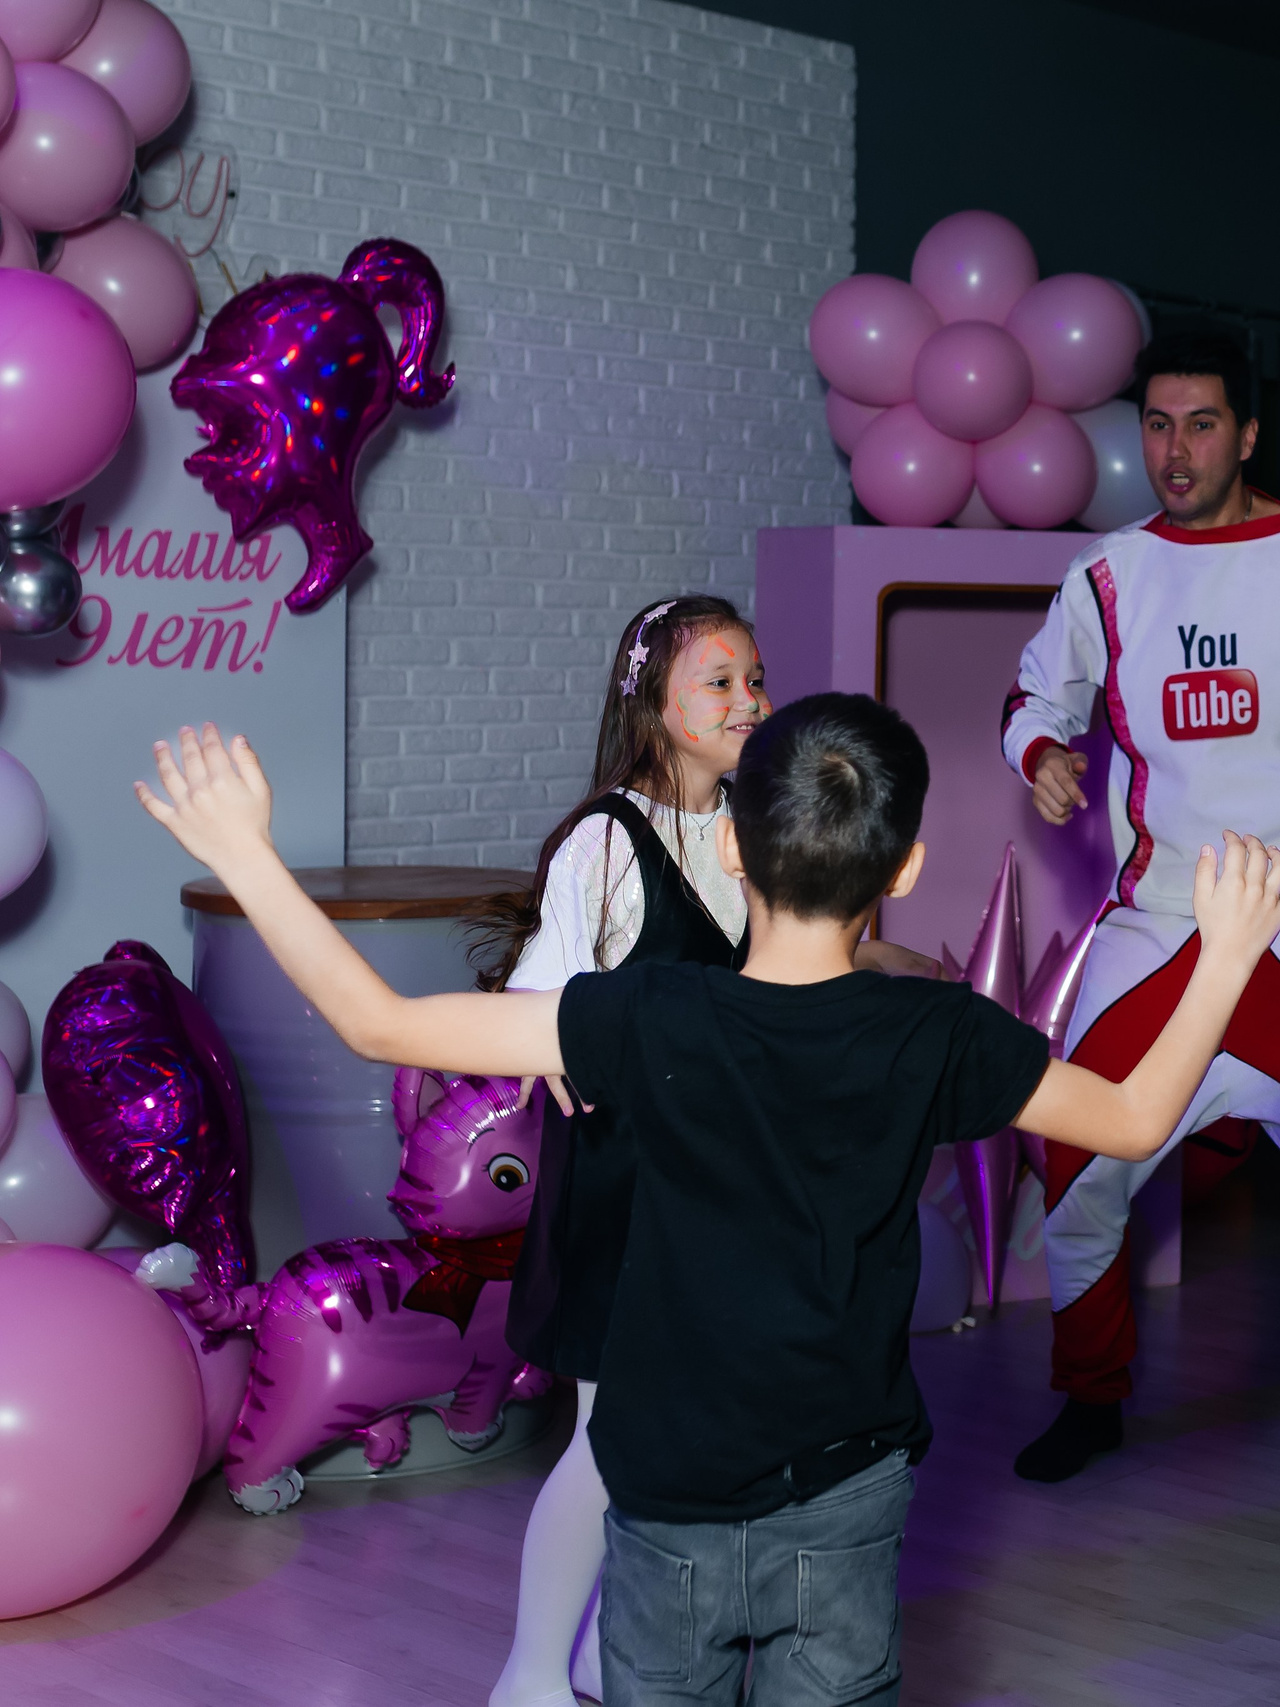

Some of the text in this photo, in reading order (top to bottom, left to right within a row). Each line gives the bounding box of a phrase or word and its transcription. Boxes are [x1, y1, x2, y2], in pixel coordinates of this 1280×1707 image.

[55, 594, 282, 673] 9 лет!
[1177, 624, 1238, 669] You
[1168, 679, 1253, 730] Tube
